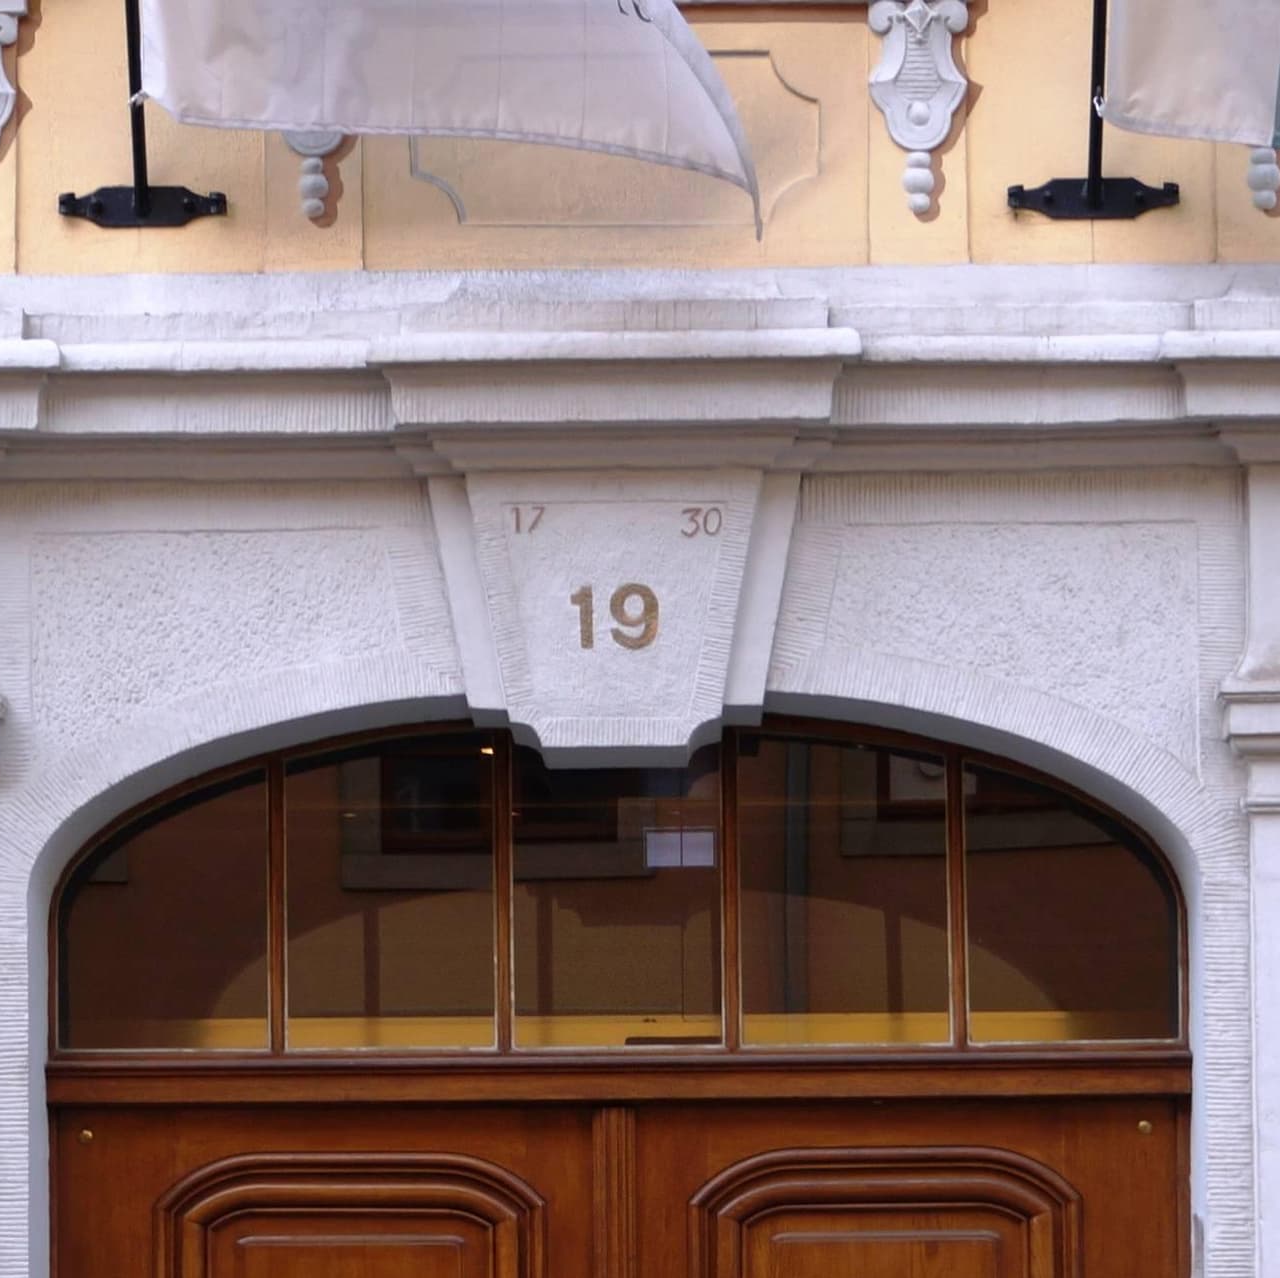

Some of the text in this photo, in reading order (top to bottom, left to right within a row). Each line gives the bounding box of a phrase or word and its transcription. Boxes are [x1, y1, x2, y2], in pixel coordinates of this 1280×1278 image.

[511, 506, 723, 538] 17 30
[569, 582, 660, 650] 19
